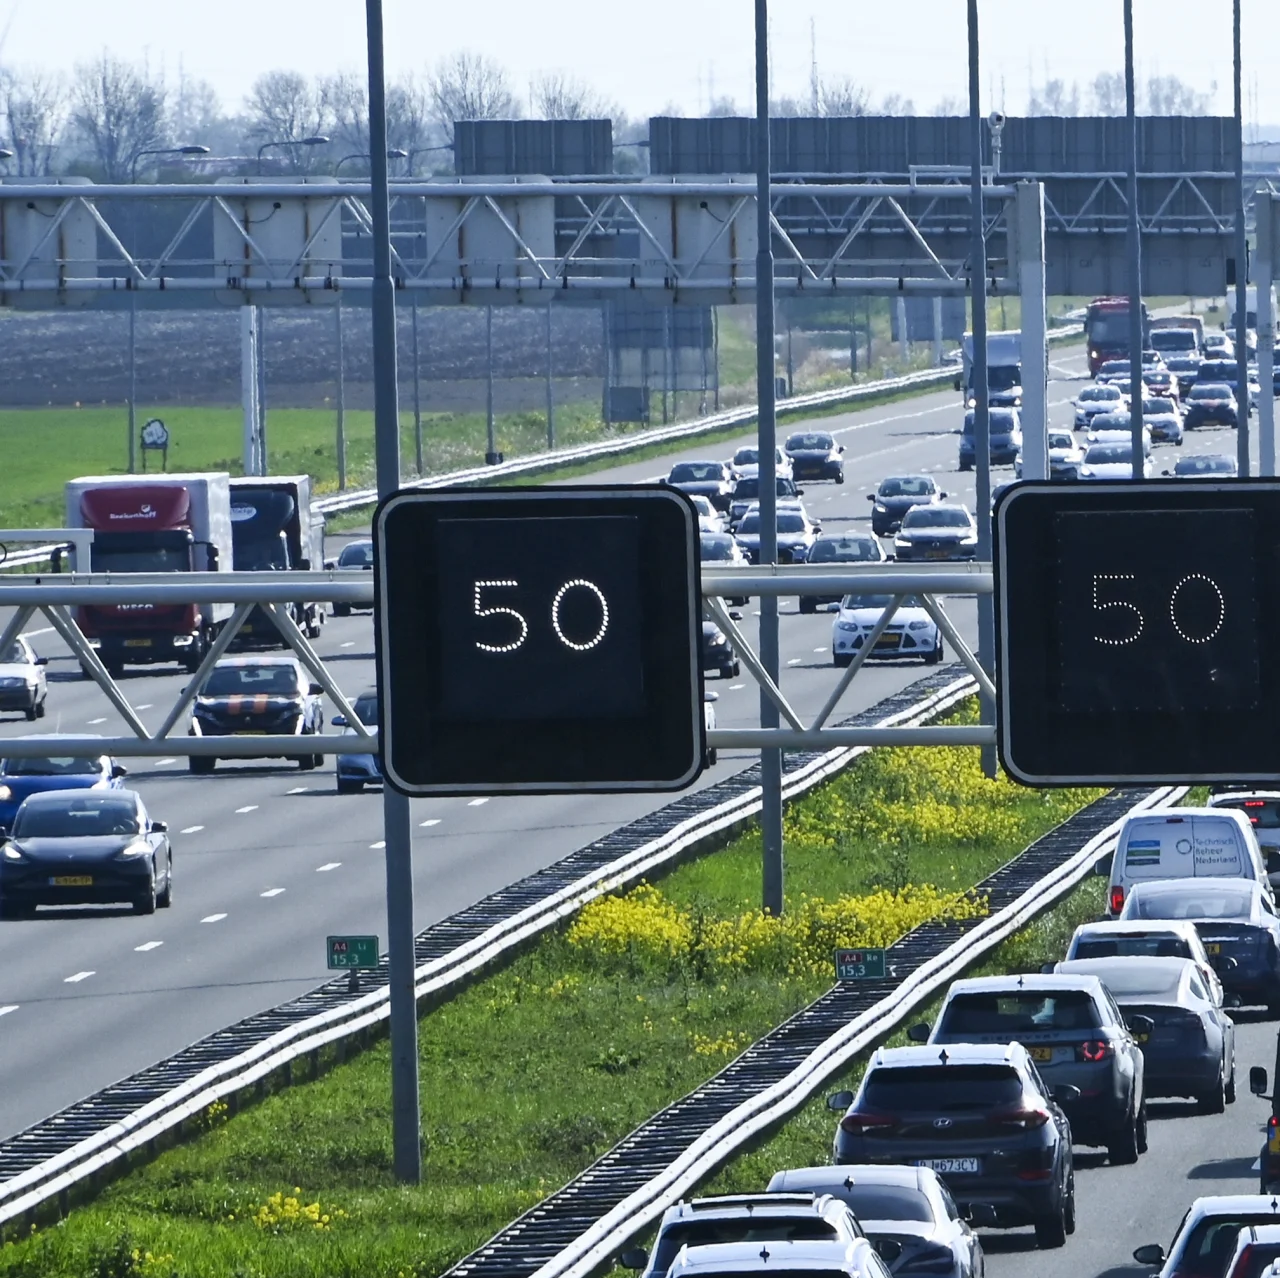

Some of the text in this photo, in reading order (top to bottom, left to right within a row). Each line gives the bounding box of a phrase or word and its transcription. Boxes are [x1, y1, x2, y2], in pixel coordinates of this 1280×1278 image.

[1092, 573, 1226, 645] 50
[474, 578, 610, 652] 50
[1194, 837, 1234, 847] Technisch
[1195, 847, 1223, 855] Beheer
[1195, 856, 1238, 864] Nederland
[334, 943, 347, 951] A4
[845, 955, 857, 963] A4
[840, 964, 866, 977] 15,3
